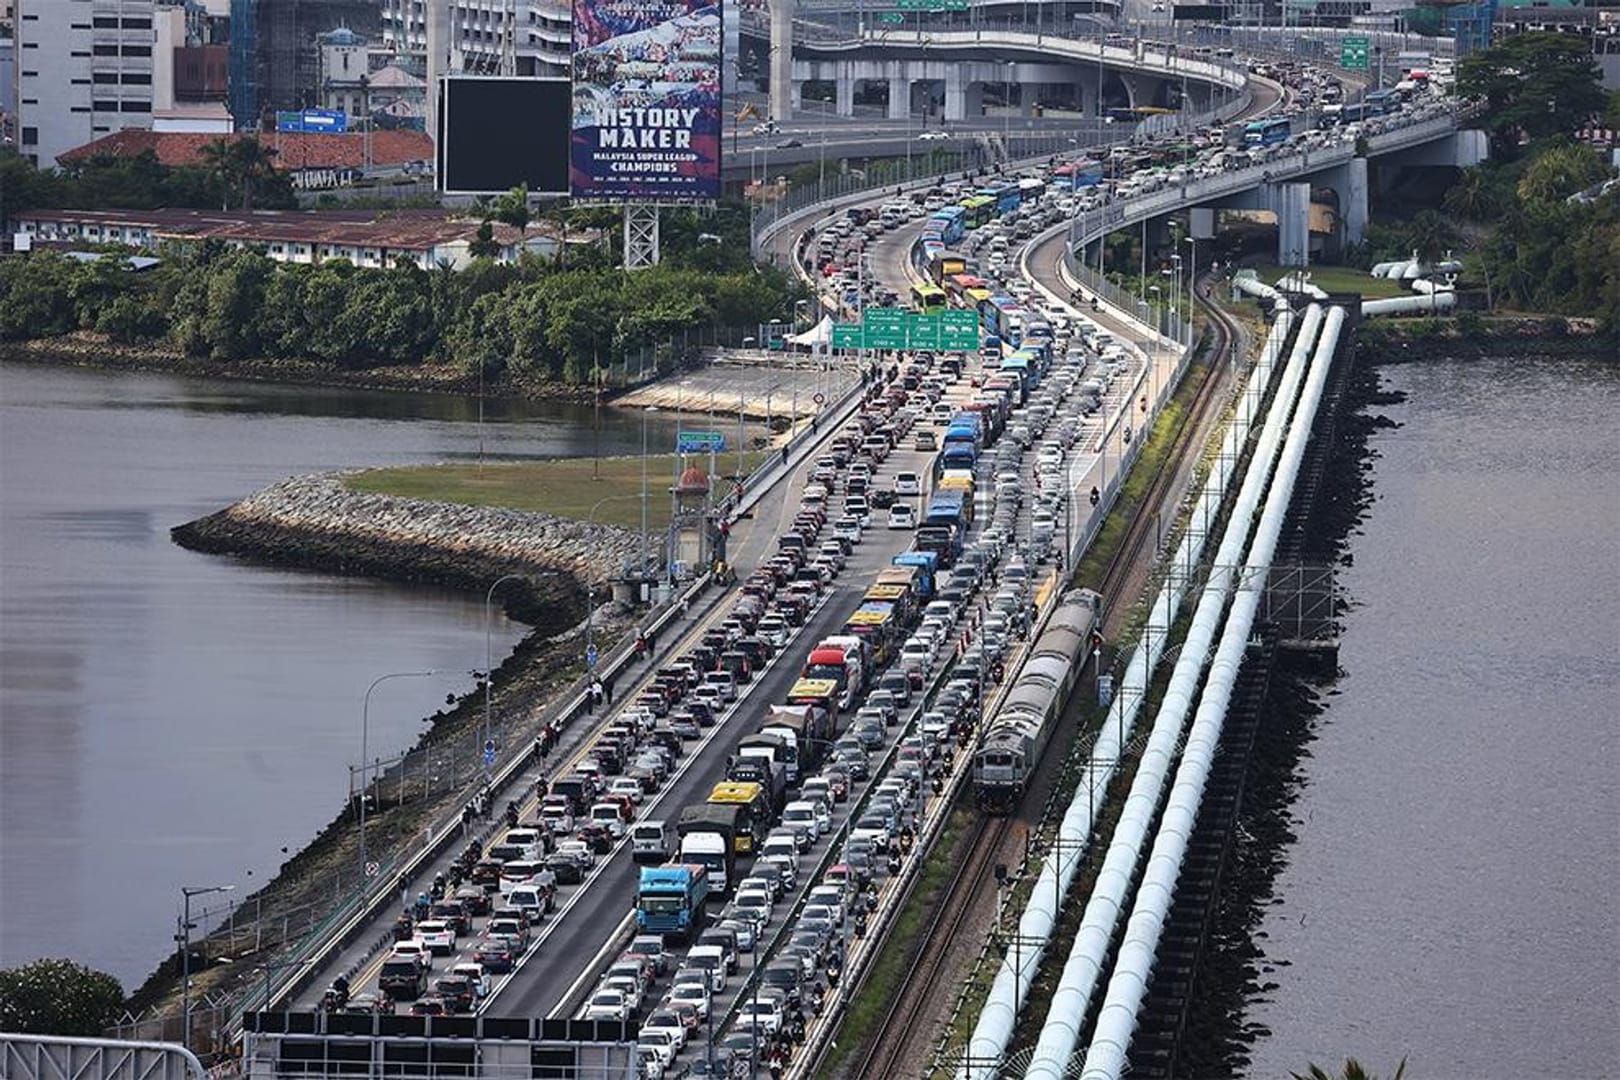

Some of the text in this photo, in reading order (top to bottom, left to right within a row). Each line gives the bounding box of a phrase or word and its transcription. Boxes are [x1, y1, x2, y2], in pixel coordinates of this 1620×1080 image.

[594, 108, 699, 127] HISTORY
[600, 128, 690, 148] MAKER
[594, 153, 635, 161] MALAYSIA
[637, 153, 663, 161] SUPER
[611, 163, 677, 172] CHAMPIONS
